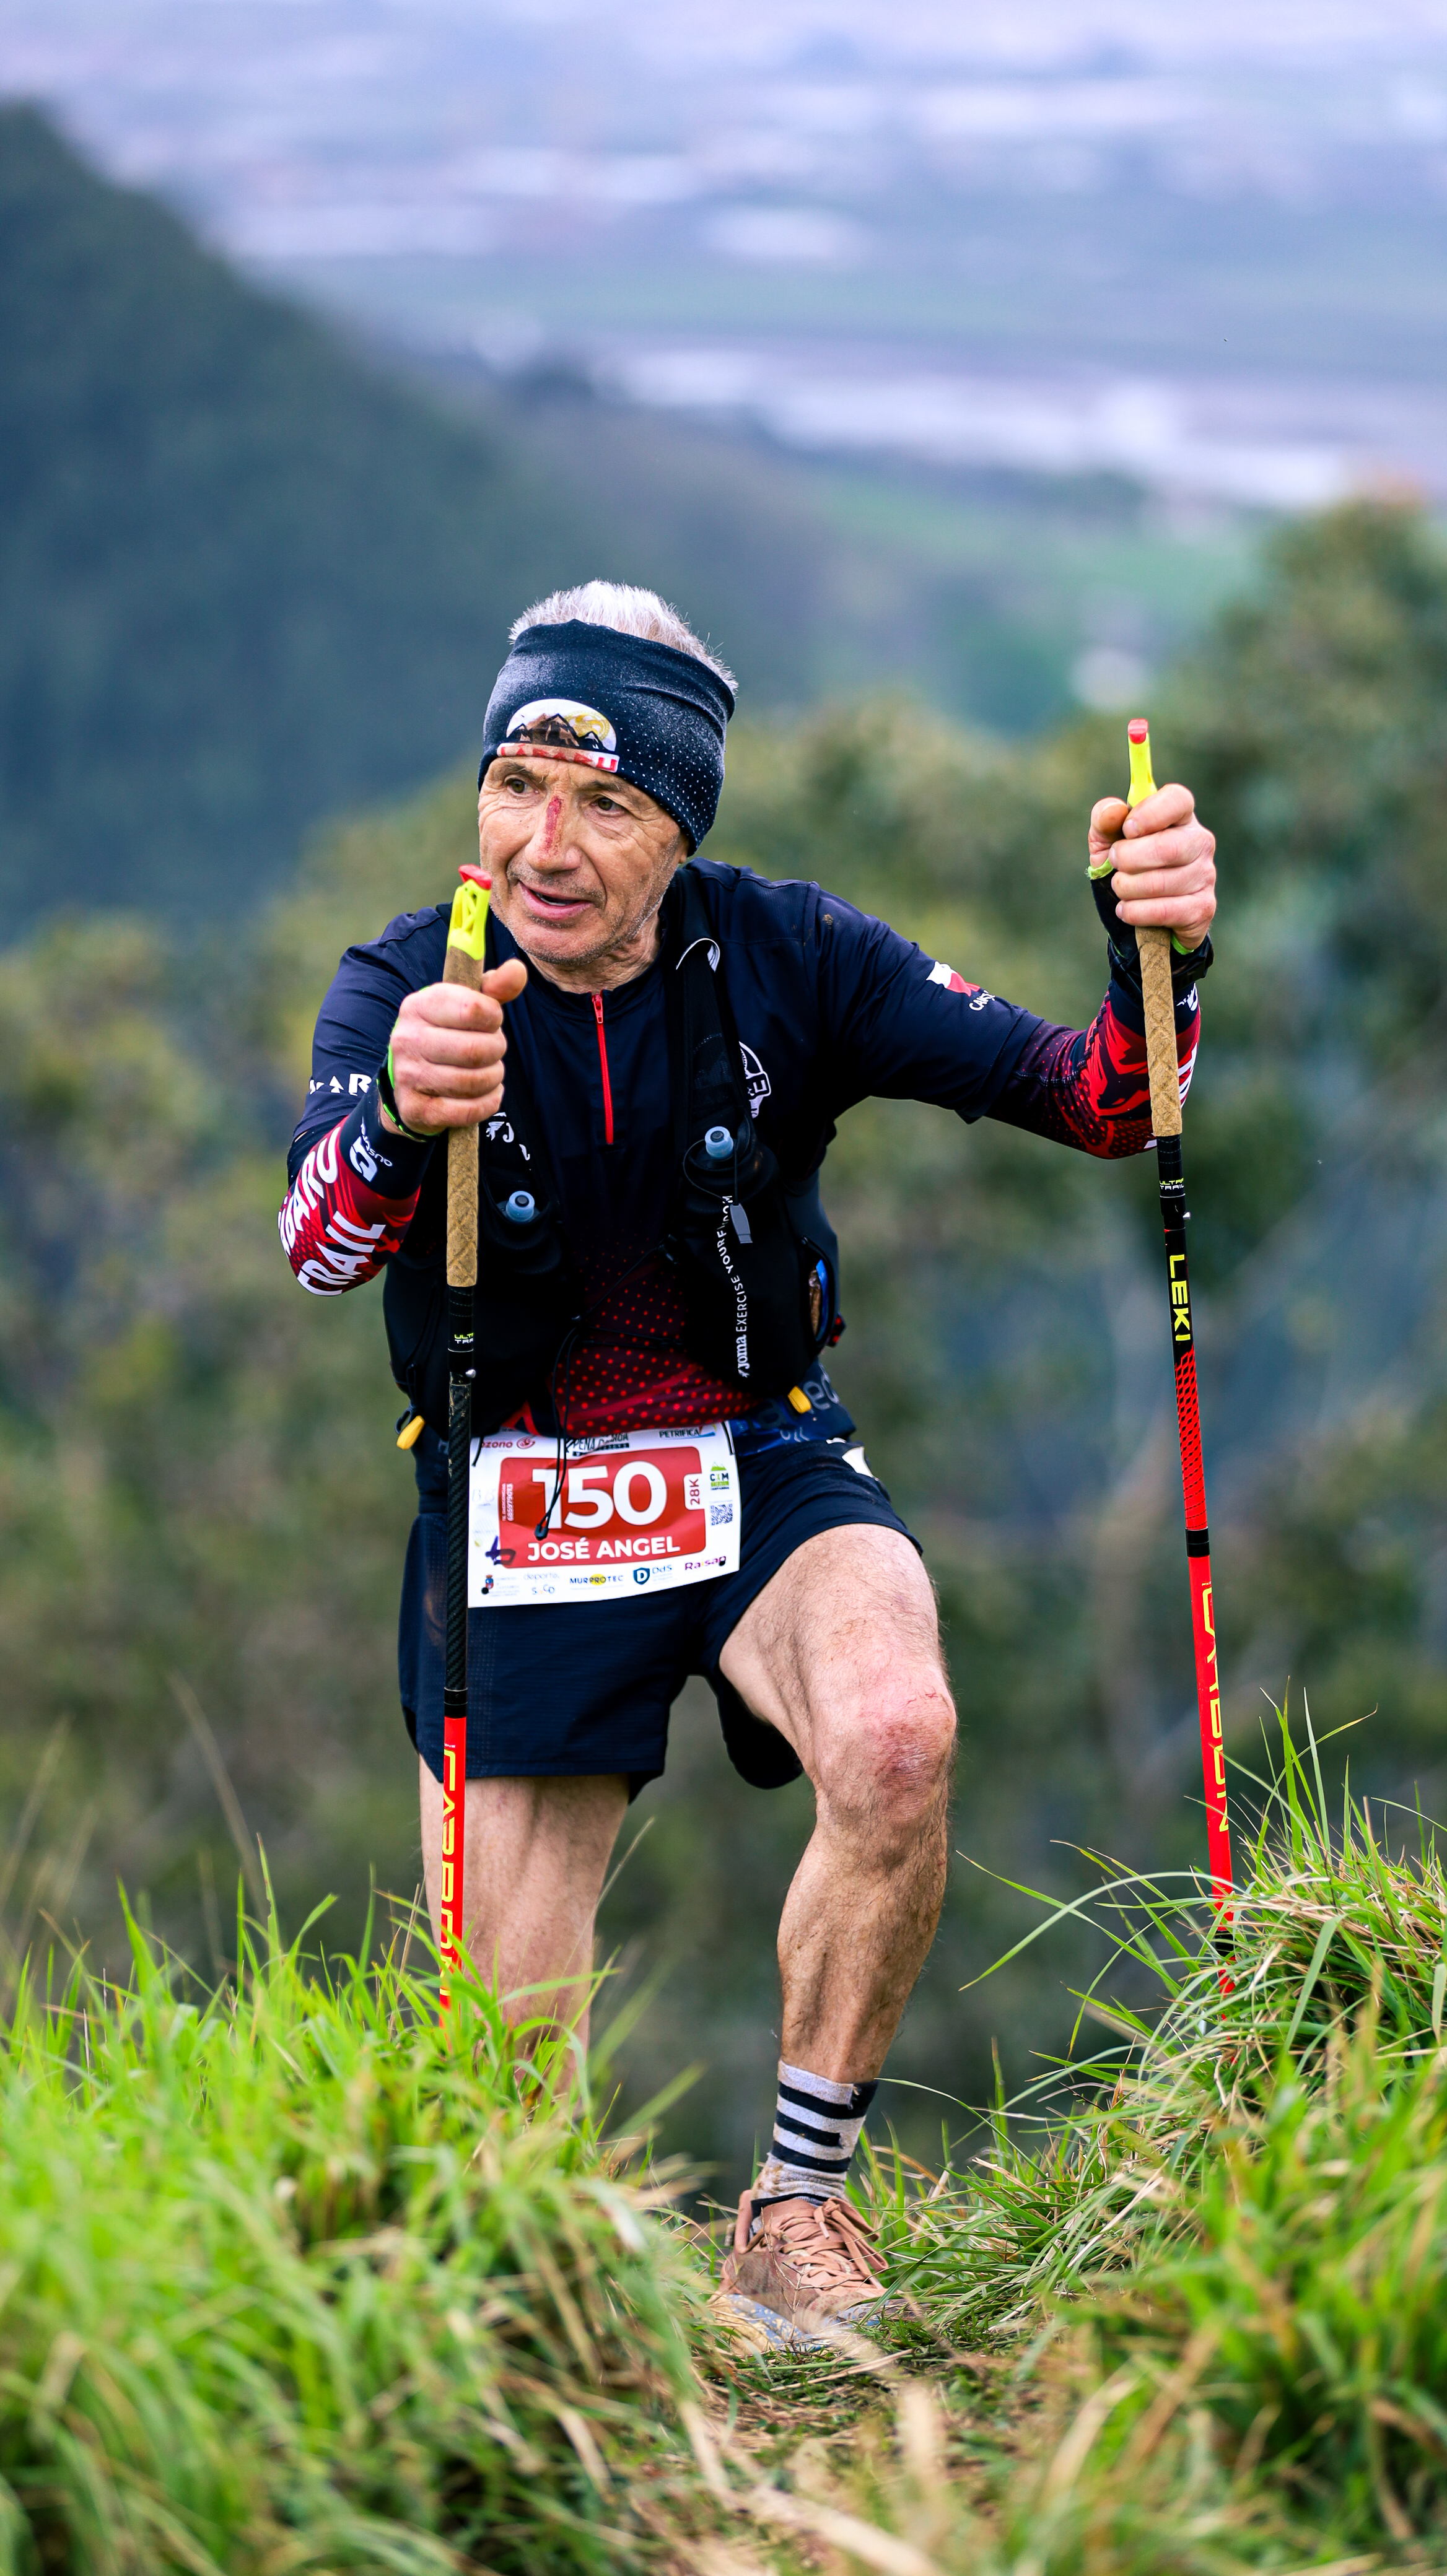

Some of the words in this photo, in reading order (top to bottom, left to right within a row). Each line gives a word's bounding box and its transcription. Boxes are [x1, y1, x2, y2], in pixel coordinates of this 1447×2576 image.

[297, 1211, 387, 1296] TRAIL
[717, 1238, 734, 1274] YOUR
[730, 1275, 748, 1332] EXERCISE
[1169, 1254, 1191, 1341] LEKI
[531, 1460, 668, 1530] 150
[689, 1478, 701, 1505] 28K
[527, 1537, 590, 1562] JOSÉ
[597, 1536, 681, 1559] ANGEL
[569, 1575, 624, 1584] MURPROTEC
